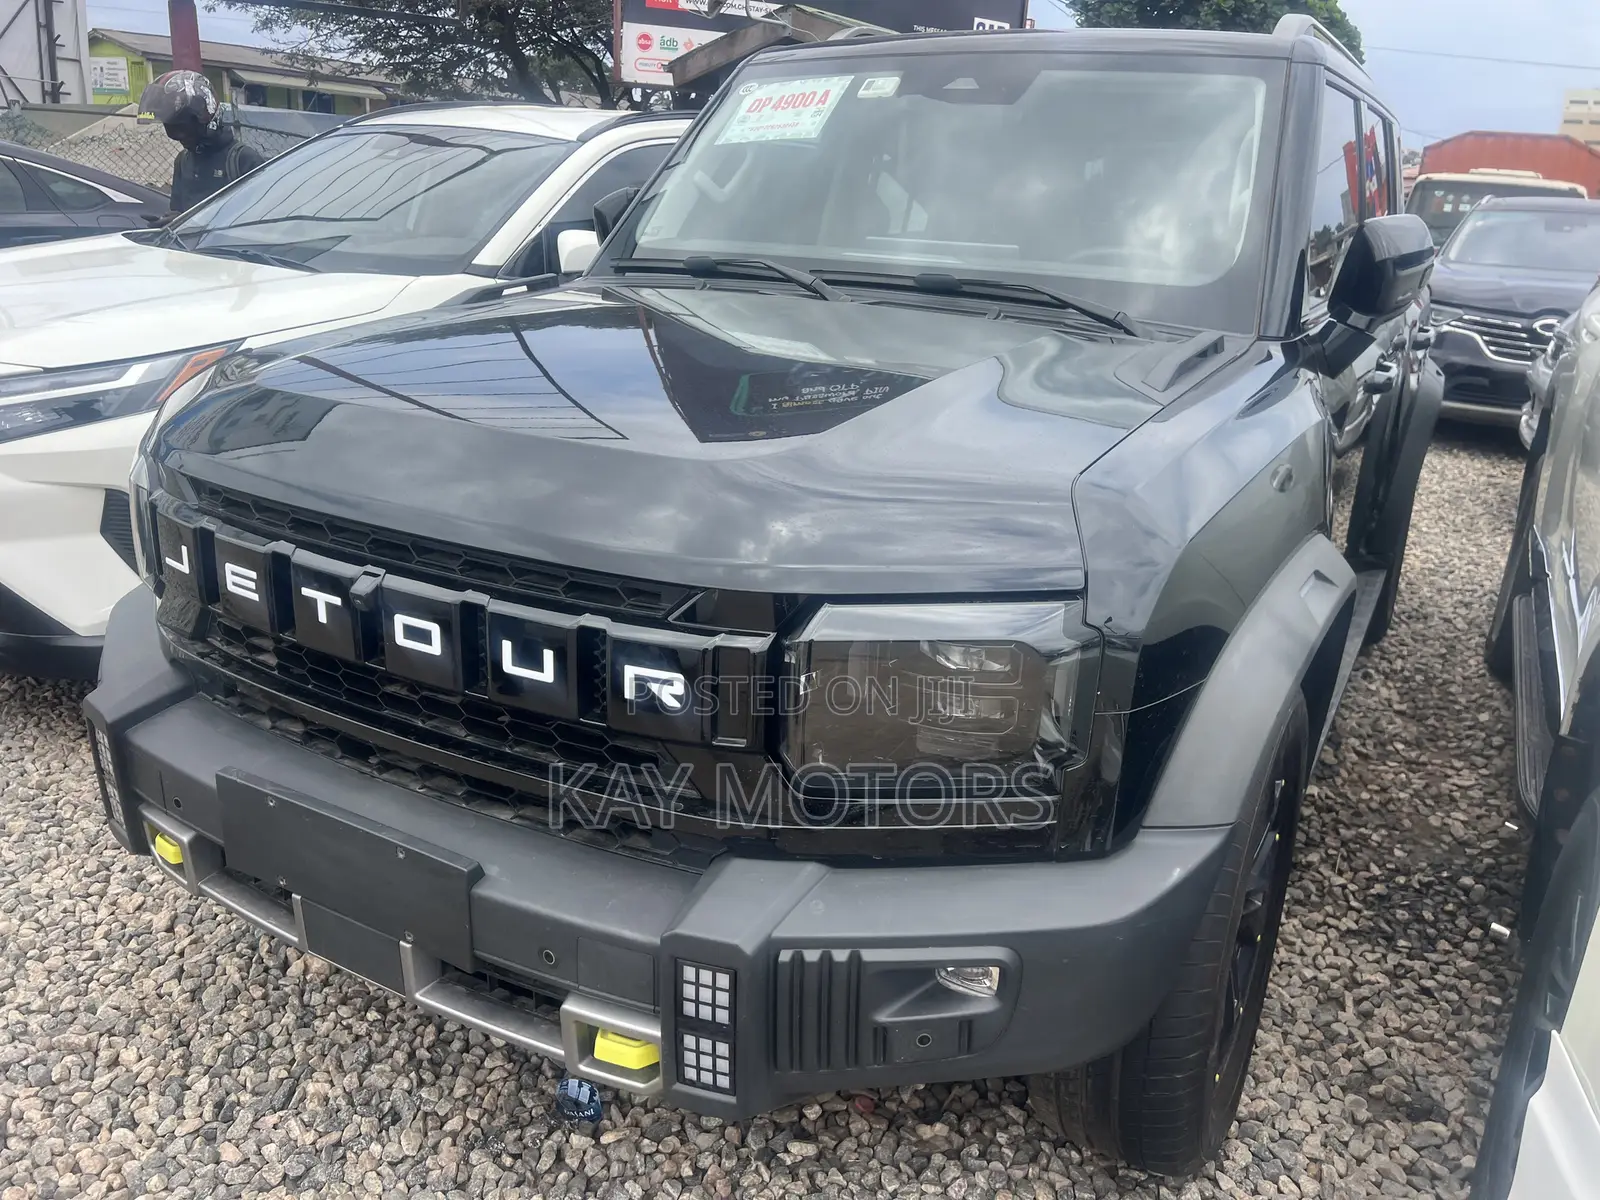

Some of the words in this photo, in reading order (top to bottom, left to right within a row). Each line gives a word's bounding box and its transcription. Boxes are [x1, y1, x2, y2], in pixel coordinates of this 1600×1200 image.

[746, 96, 772, 113] DP
[770, 90, 818, 112] 4900
[815, 88, 832, 107] A
[165, 543, 686, 709] JETOUR
